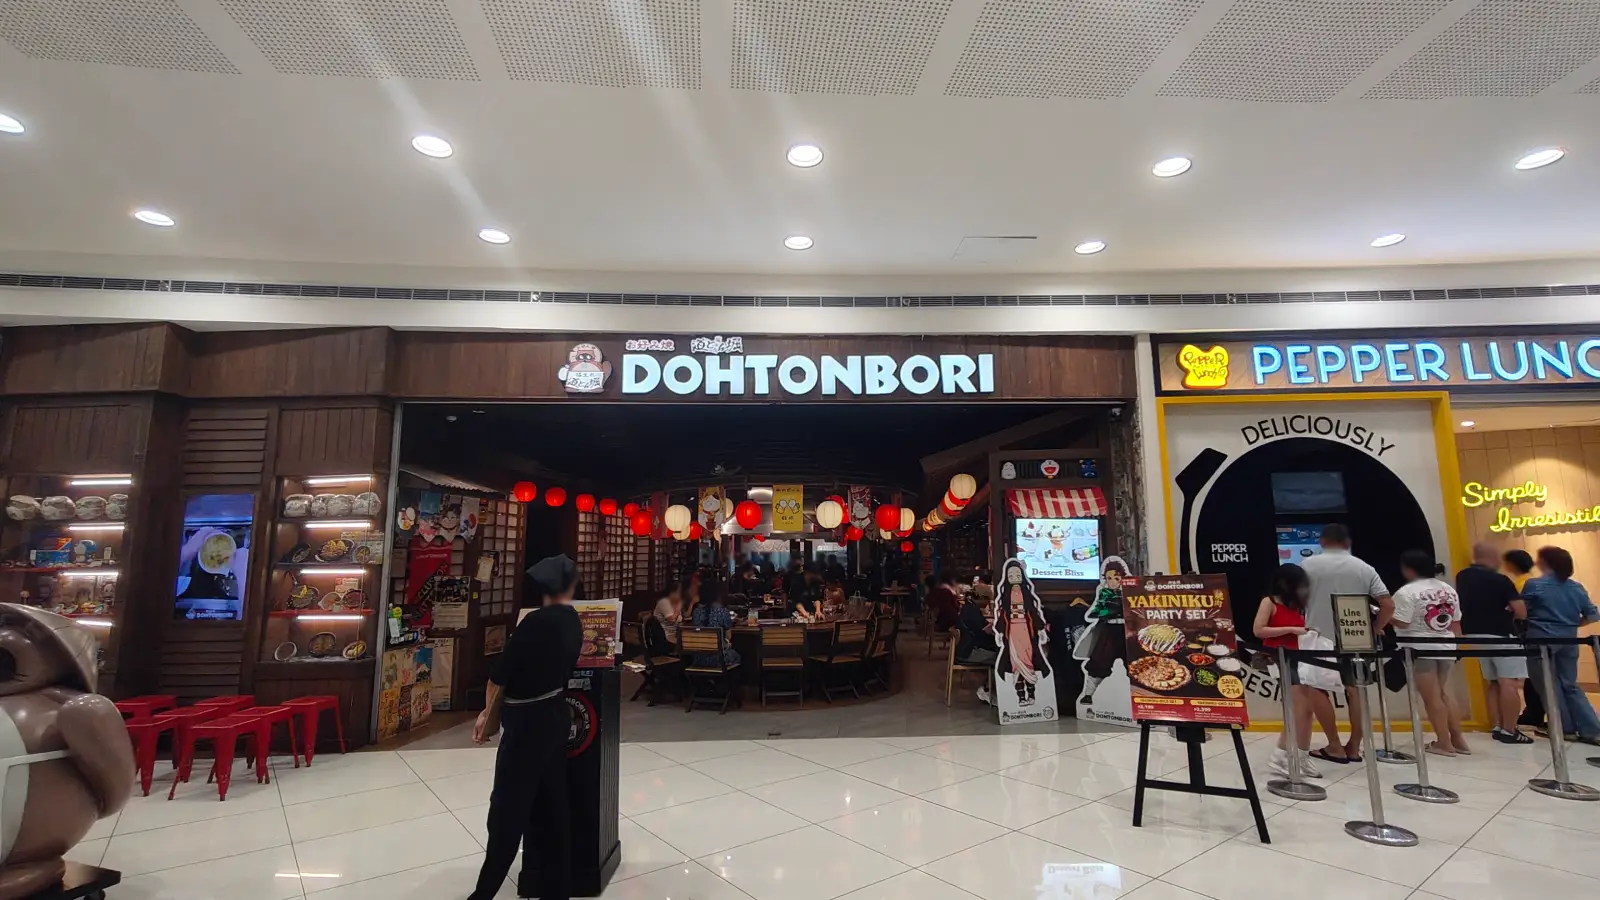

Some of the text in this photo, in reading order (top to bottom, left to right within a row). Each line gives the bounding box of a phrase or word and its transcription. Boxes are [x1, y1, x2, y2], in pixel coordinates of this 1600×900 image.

[1252, 339, 1450, 385] PEPPER
[622, 353, 994, 395] DOHTONBORI
[1241, 415, 1395, 457] DELICIOUSLY
[1461, 480, 1548, 507] Simply
[1211, 543, 1247, 553] PEPPER
[1212, 553, 1249, 563] LUNCH
[1031, 568, 1085, 577] Dessert Bliss
[1126, 594, 1214, 609] YAKINIKU
[1146, 609, 1208, 620] PARTY SET
[1343, 609, 1361, 617] Line
[1340, 619, 1367, 627] Starts
[1344, 628, 1365, 636] Here
